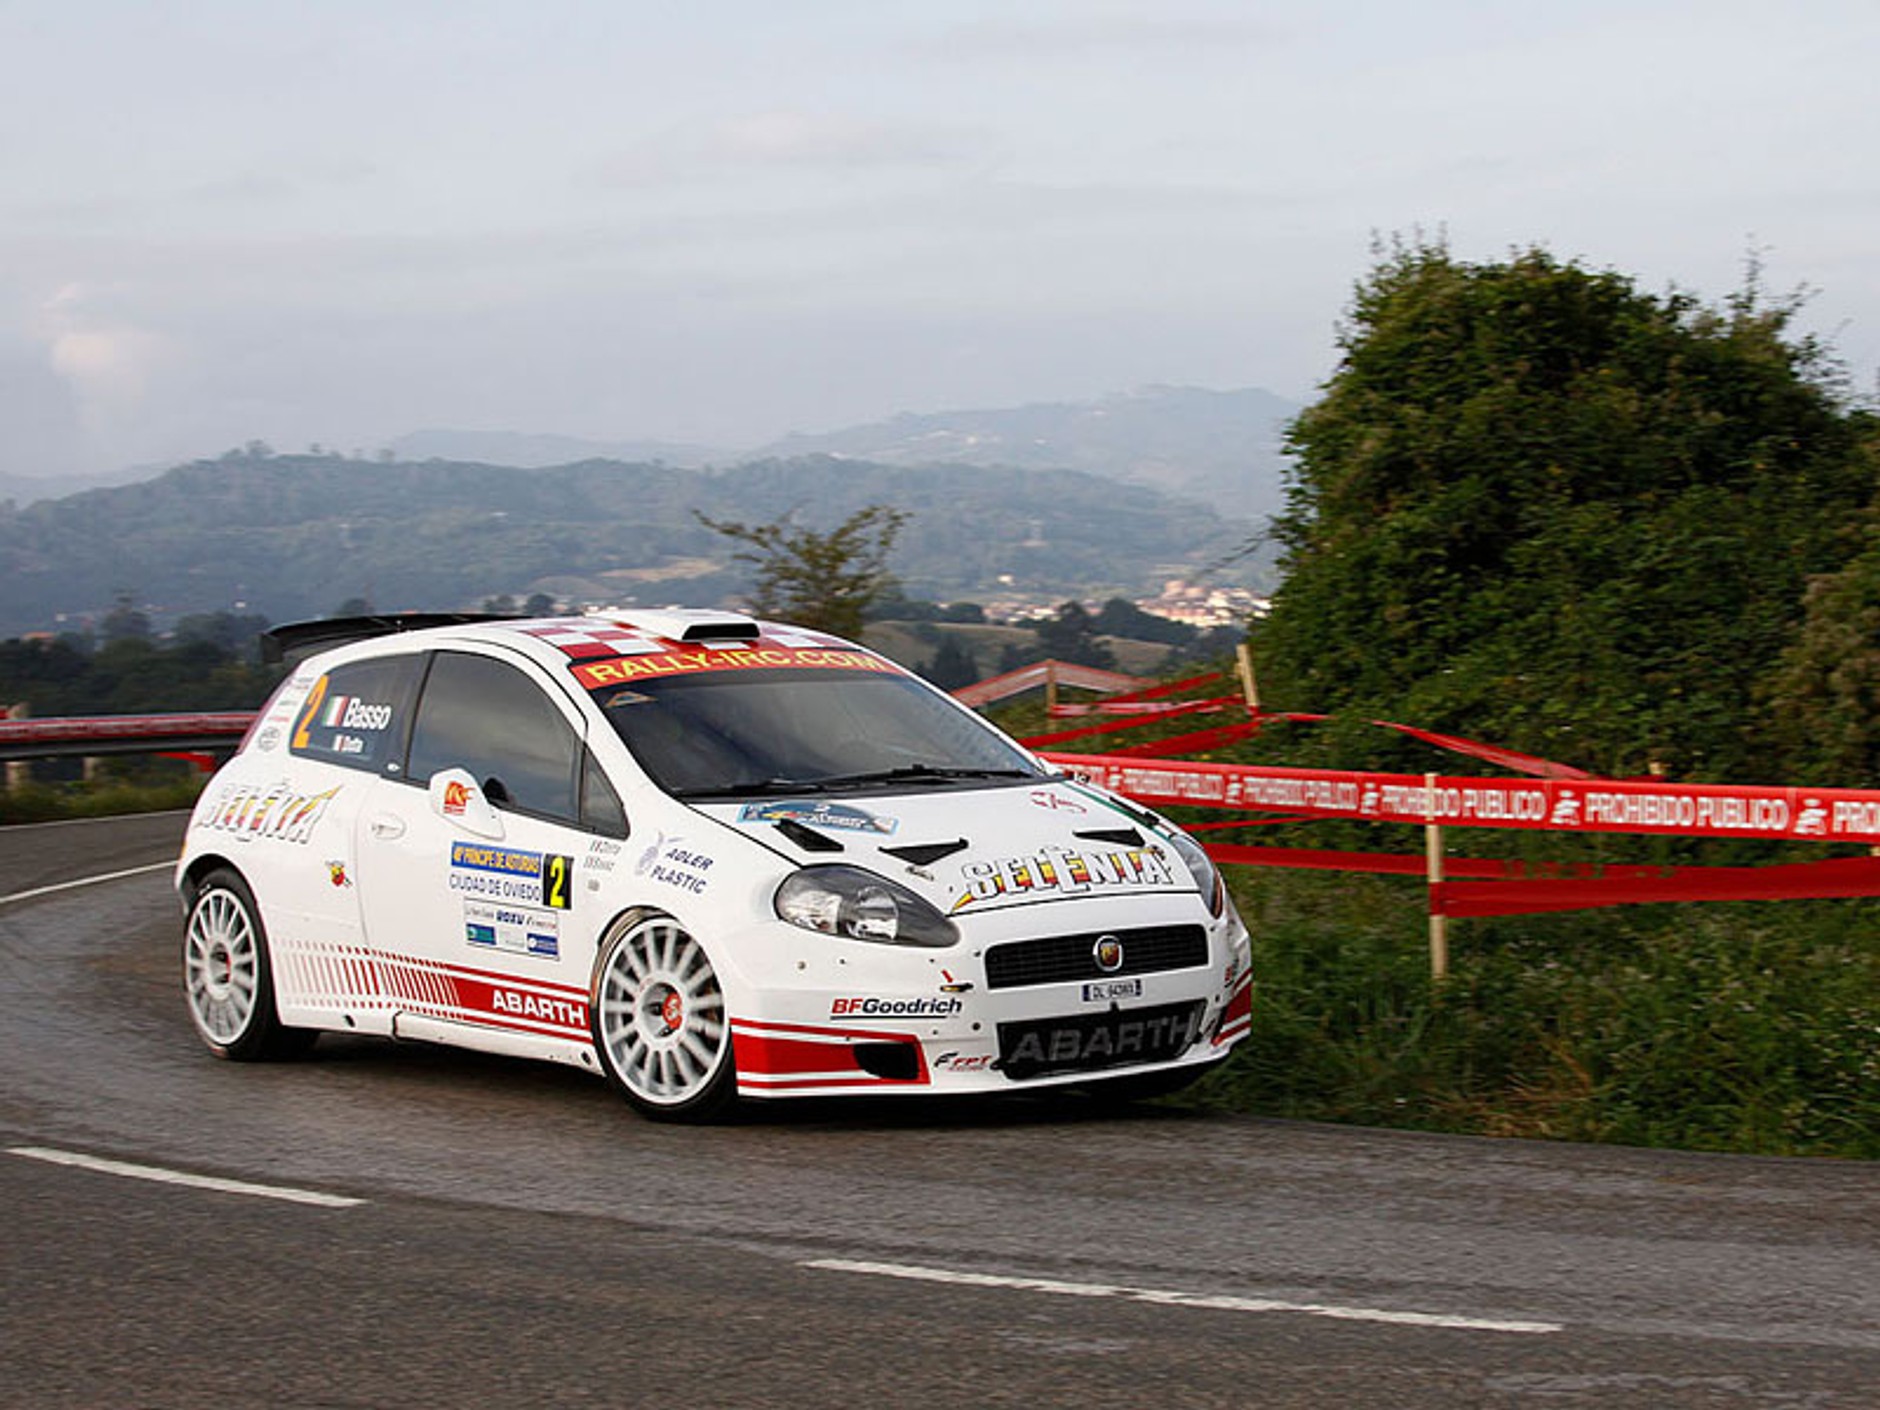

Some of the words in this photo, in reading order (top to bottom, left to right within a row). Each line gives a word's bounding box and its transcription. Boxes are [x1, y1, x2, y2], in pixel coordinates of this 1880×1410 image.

[586, 650, 886, 682] RALLY-IRC.COM
[292, 674, 330, 748] 2
[343, 698, 391, 730] Basso
[1462, 788, 1546, 821] PUBLICO
[1585, 792, 1696, 827] PROHIBIDO
[1697, 796, 1789, 830] PUBLICO
[665, 848, 714, 871] ADLER
[550, 856, 565, 907] 2
[651, 865, 707, 894] PLASTIC
[492, 989, 586, 1025] ABARTH
[831, 997, 963, 1014] BFGoodrich
[1009, 1011, 1197, 1063] ABARTH
